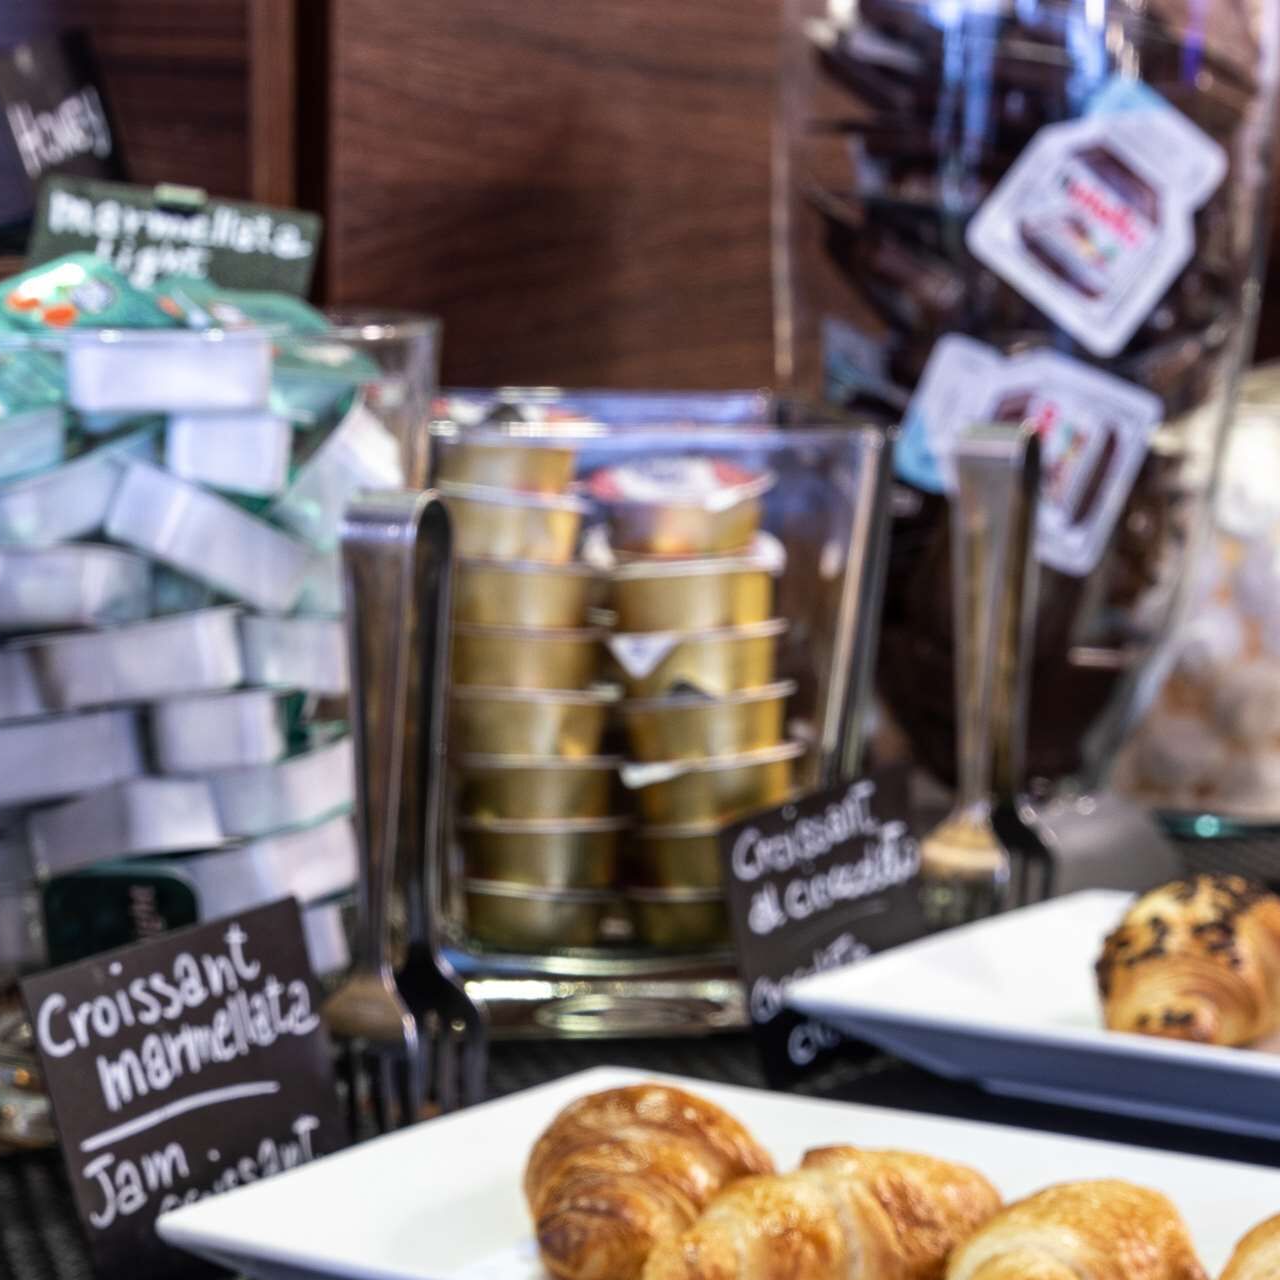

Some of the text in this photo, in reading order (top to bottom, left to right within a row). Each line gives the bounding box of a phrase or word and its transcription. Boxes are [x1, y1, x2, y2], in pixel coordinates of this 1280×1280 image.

[37, 923, 261, 1057] Croissant
[97, 975, 320, 1111] marmellata
[82, 1142, 190, 1229] Jam
